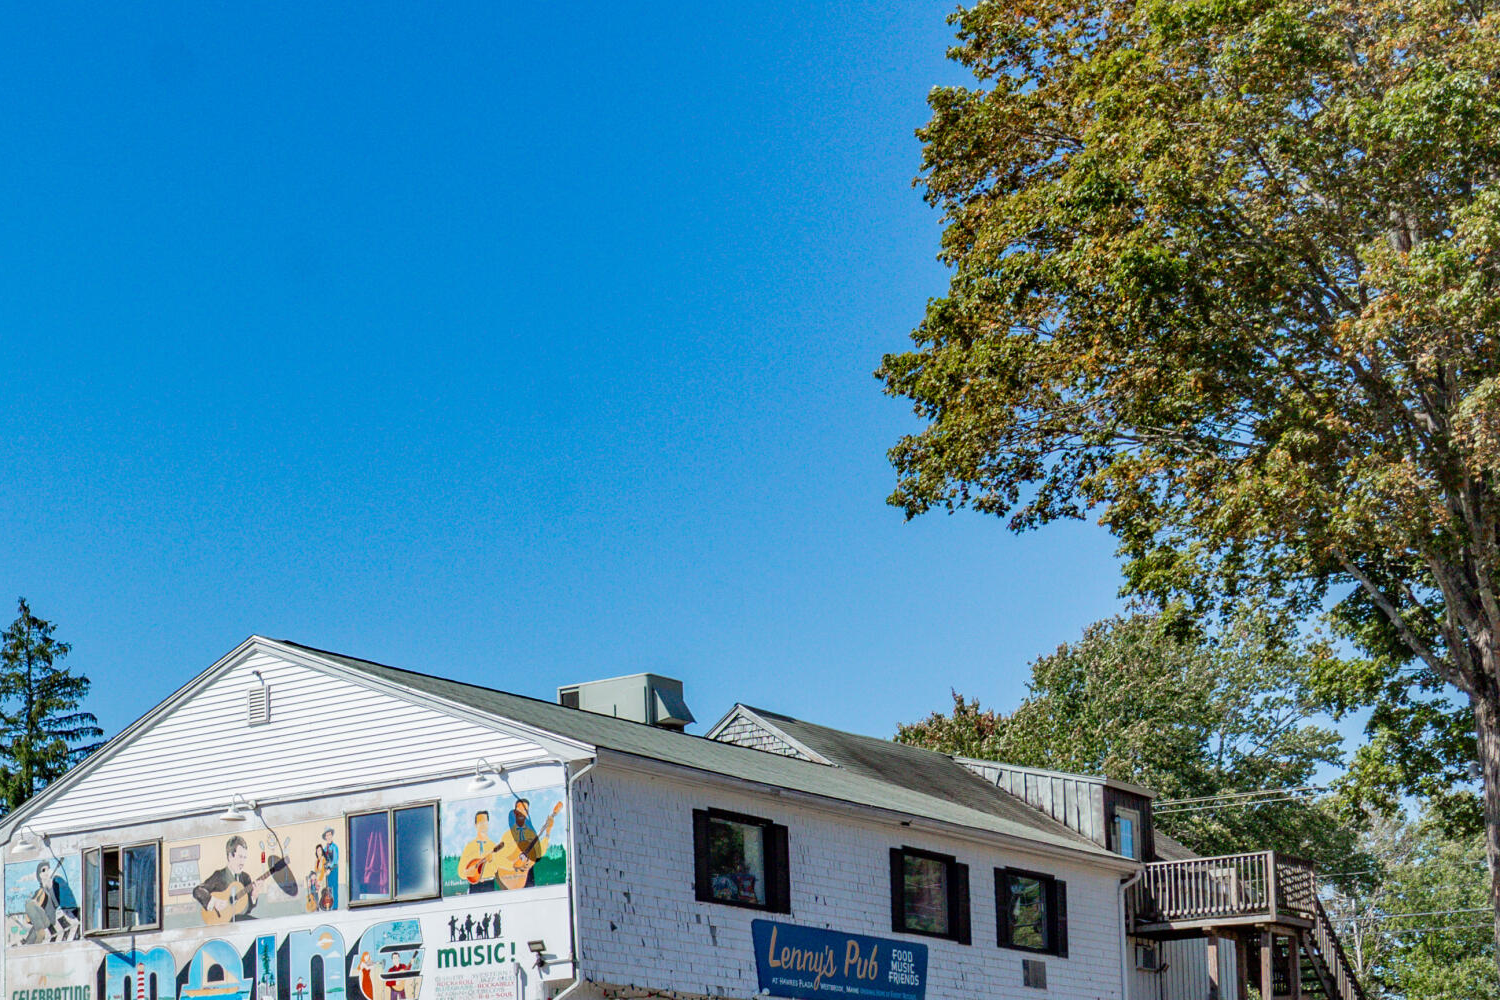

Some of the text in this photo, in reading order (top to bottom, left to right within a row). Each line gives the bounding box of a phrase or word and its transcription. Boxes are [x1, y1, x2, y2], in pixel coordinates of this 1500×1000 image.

[769, 925, 879, 991] Lenny's Pub
[892, 949, 913, 963] FOOD
[891, 960, 915, 974] MUSIC
[888, 971, 920, 986] FRIENDS
